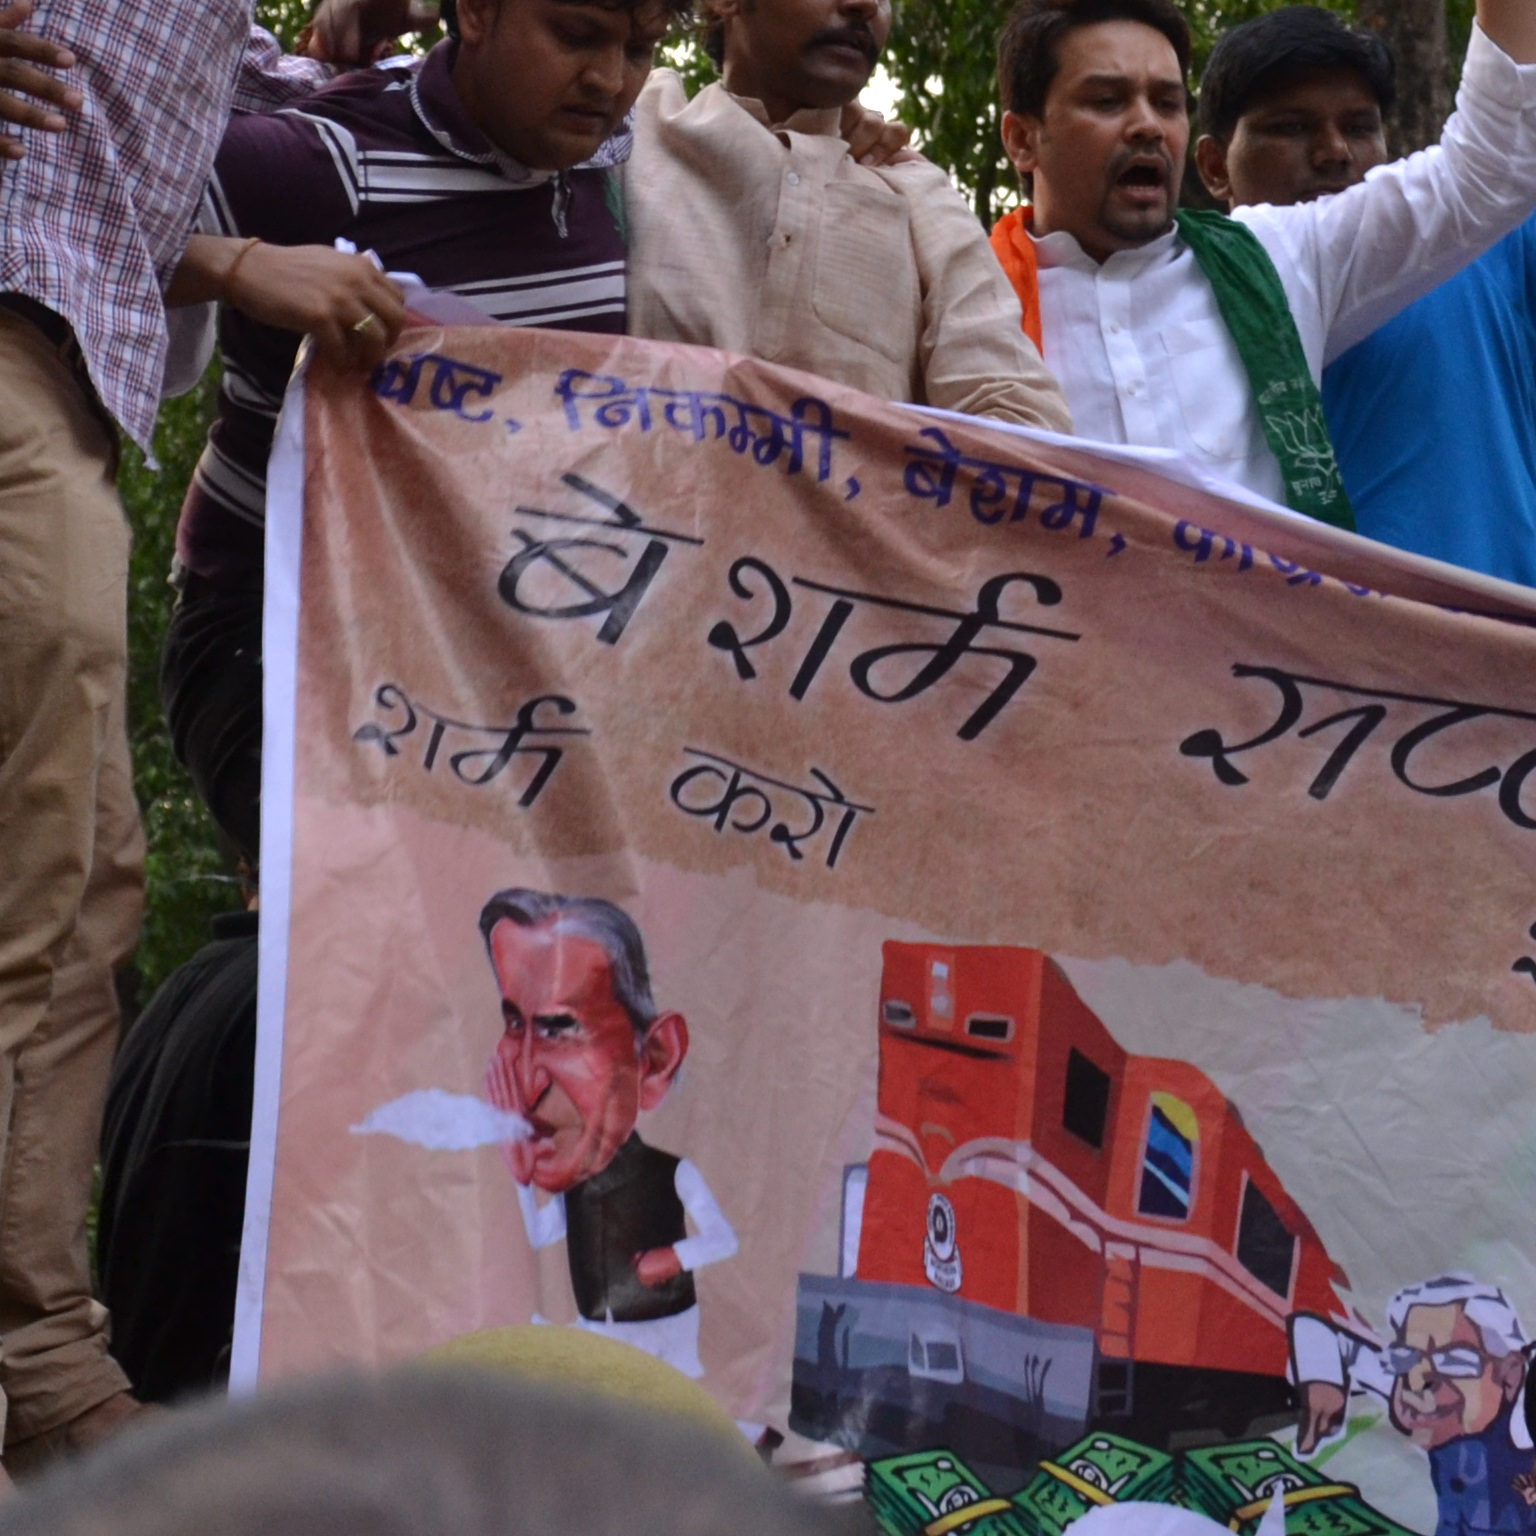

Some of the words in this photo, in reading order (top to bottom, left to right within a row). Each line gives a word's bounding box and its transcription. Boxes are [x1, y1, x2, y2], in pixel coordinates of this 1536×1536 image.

[555, 368, 862, 501] निकम्मी,
[902, 426, 1127, 557] बेशम,
[351, 682, 591, 809] शर्म
[670, 746, 877, 869] करो
